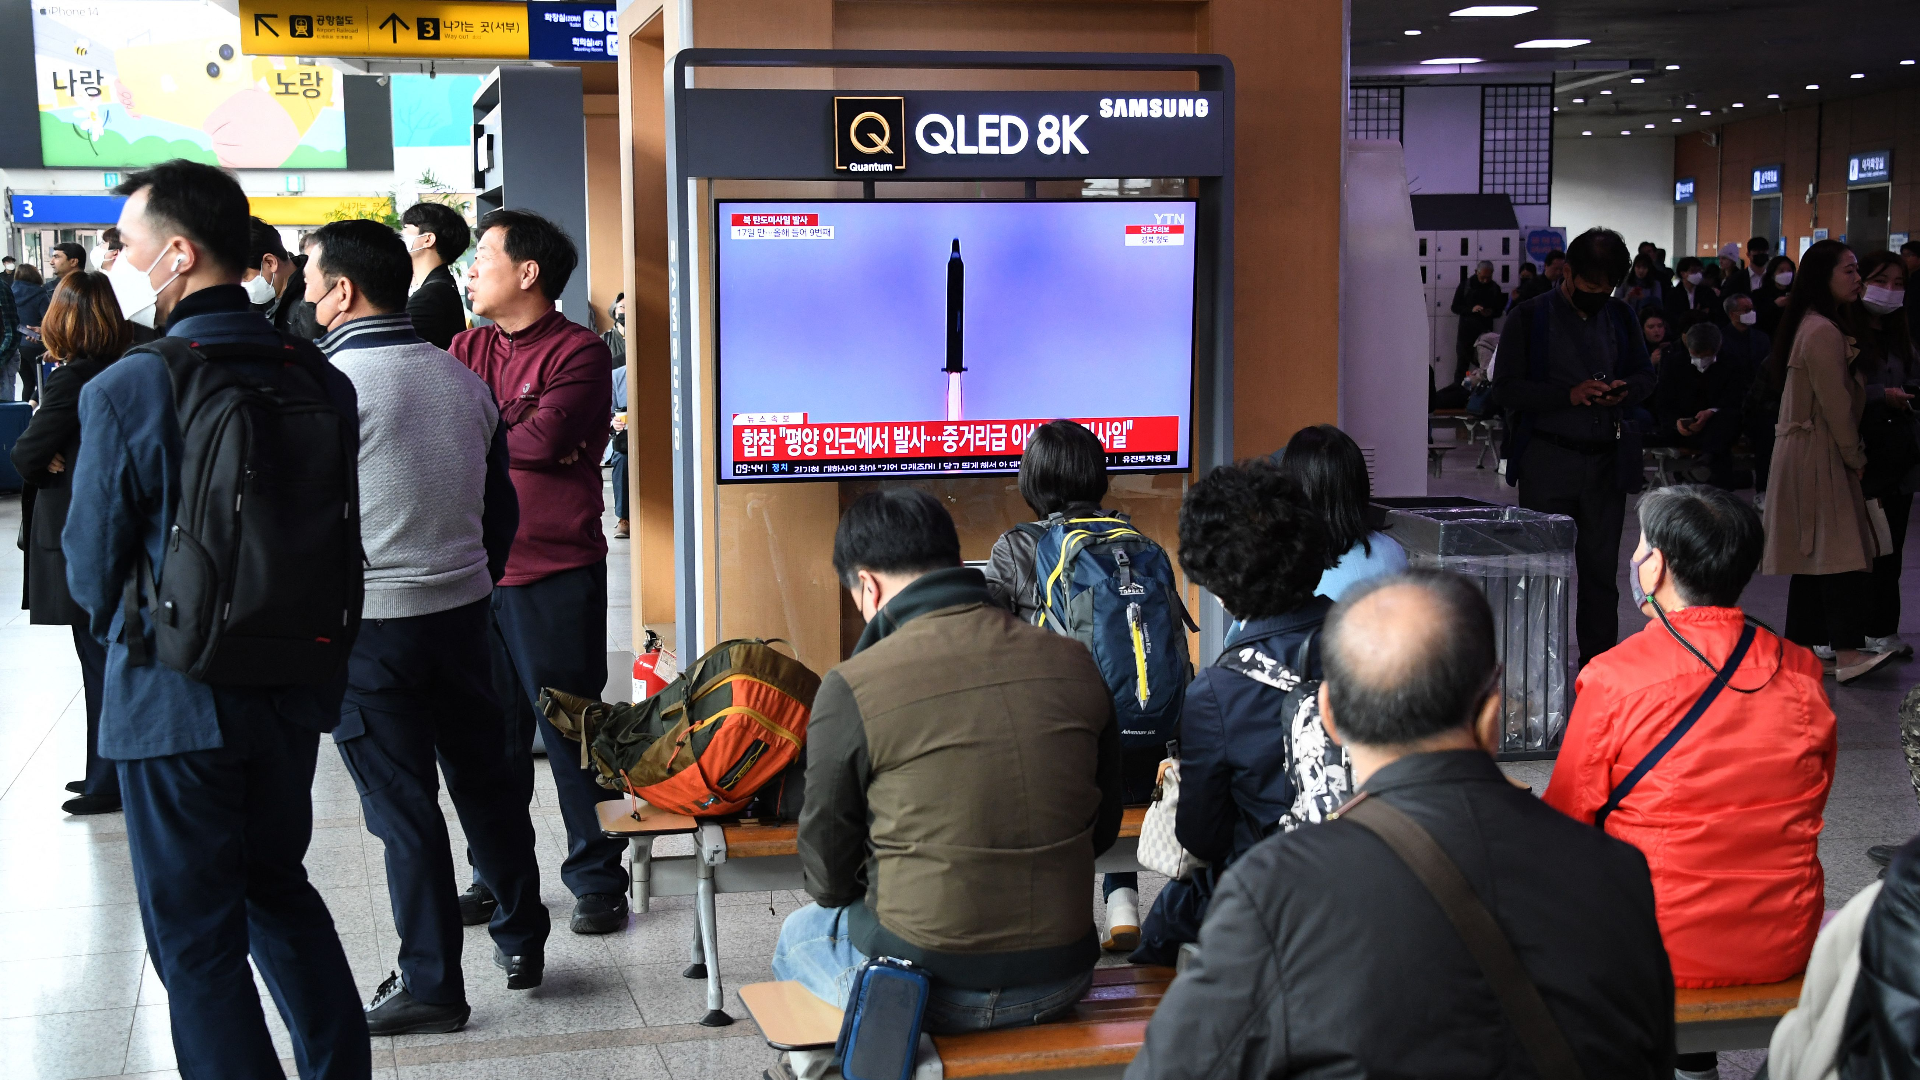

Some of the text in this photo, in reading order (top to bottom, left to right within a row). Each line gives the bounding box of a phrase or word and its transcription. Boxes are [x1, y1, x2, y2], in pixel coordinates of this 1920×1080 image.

[49, 6, 99, 16] iPhone 14
[316, 15, 354, 26] 공항철도
[443, 20, 520, 33] 나가는 곳(서부)
[423, 21, 435, 38] 3
[52, 69, 104, 97] 나랑
[275, 71, 324, 99] 노랑
[1099, 98, 1209, 118] SAMSUNG
[915, 113, 1090, 155] QLED 8K
[849, 162, 893, 173] Quantum
[22, 200, 34, 218] 3
[742, 215, 808, 225] 북 탄도미사일 발사
[1153, 213, 1185, 225] YTN
[737, 228, 754, 238] 17일
[791, 228, 807, 238] 들어
[809, 228, 831, 238] 9번째
[670, 240, 681, 451] SAMSUNG
[741, 427, 776, 457] 합참
[779, 426, 819, 456] "평양
[822, 426, 889, 455] 인근에서
[1122, 454, 1171, 464] 유진투자증권
[735, 464, 764, 474] 09:44
[771, 463, 788, 473] 정치
